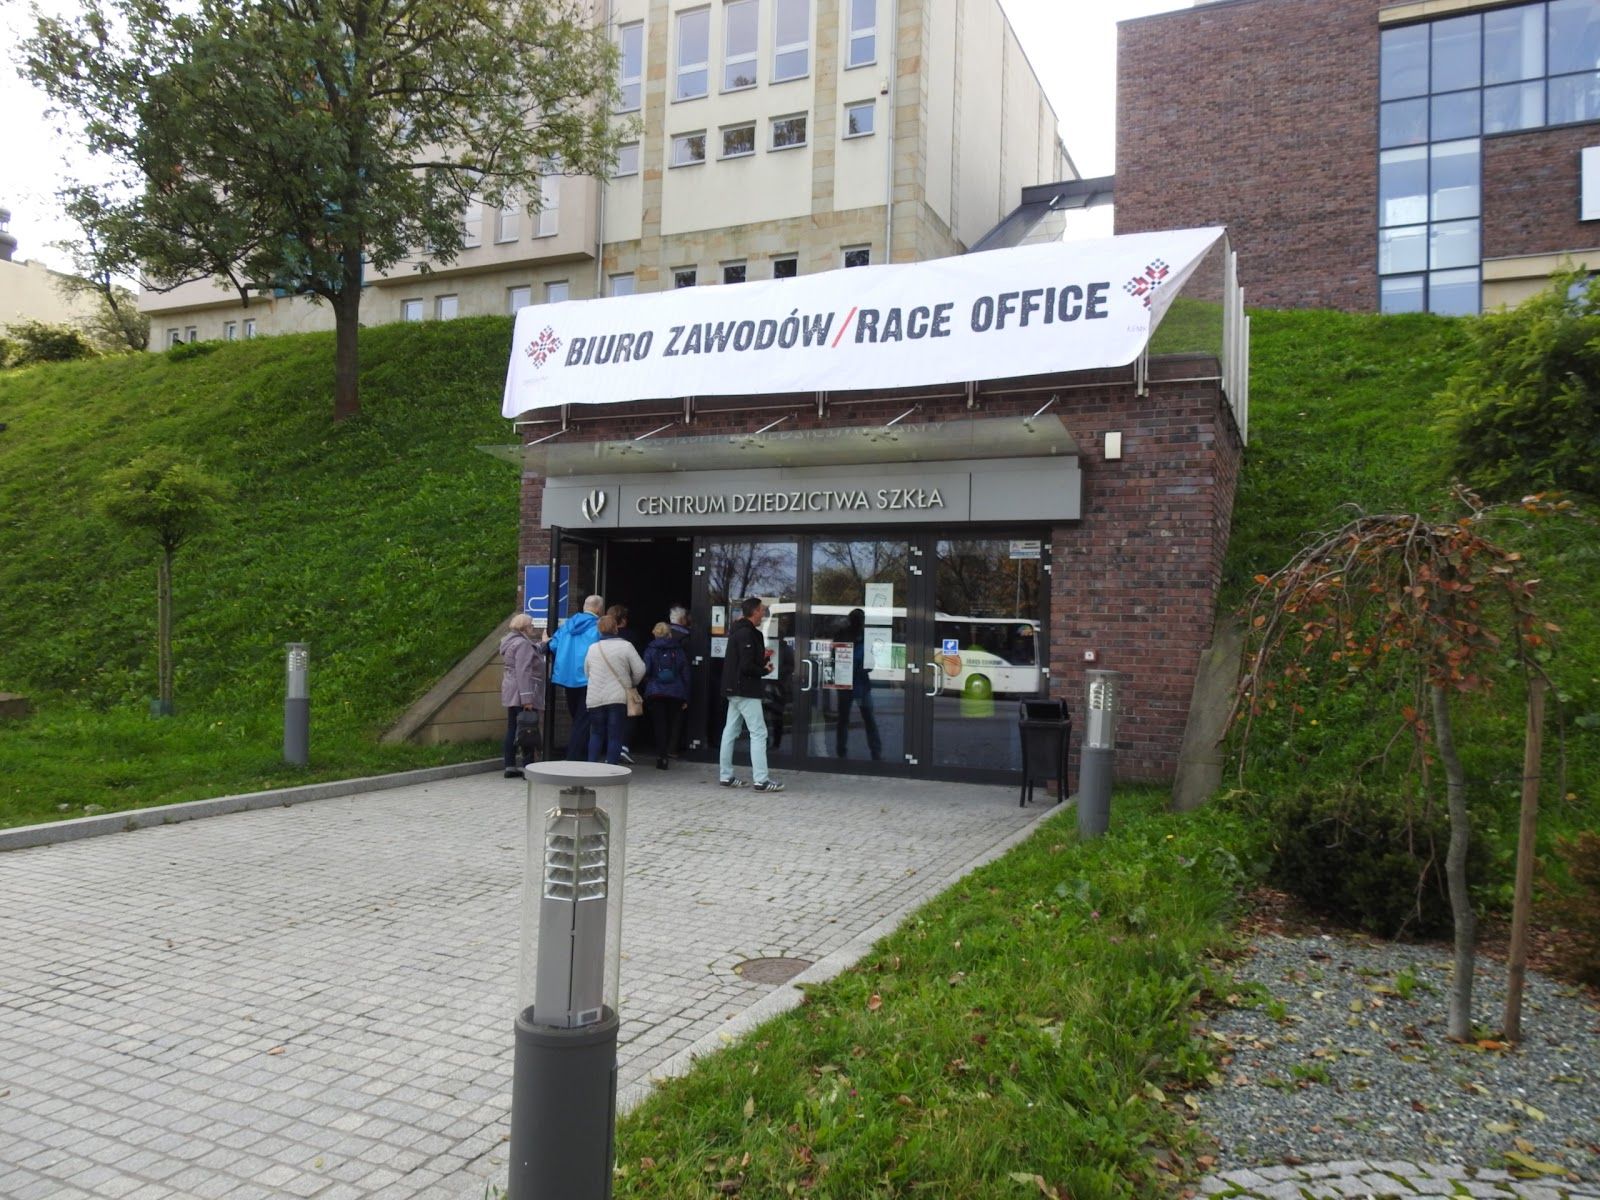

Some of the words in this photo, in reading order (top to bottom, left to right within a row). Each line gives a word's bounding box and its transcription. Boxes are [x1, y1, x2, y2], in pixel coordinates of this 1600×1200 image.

[565, 330, 655, 366] BIURO
[970, 282, 1110, 333] OFFICE
[636, 495, 725, 515] CENTRUM
[732, 490, 870, 513] DZIEDZICTWA
[876, 487, 944, 510] SZKŁA
